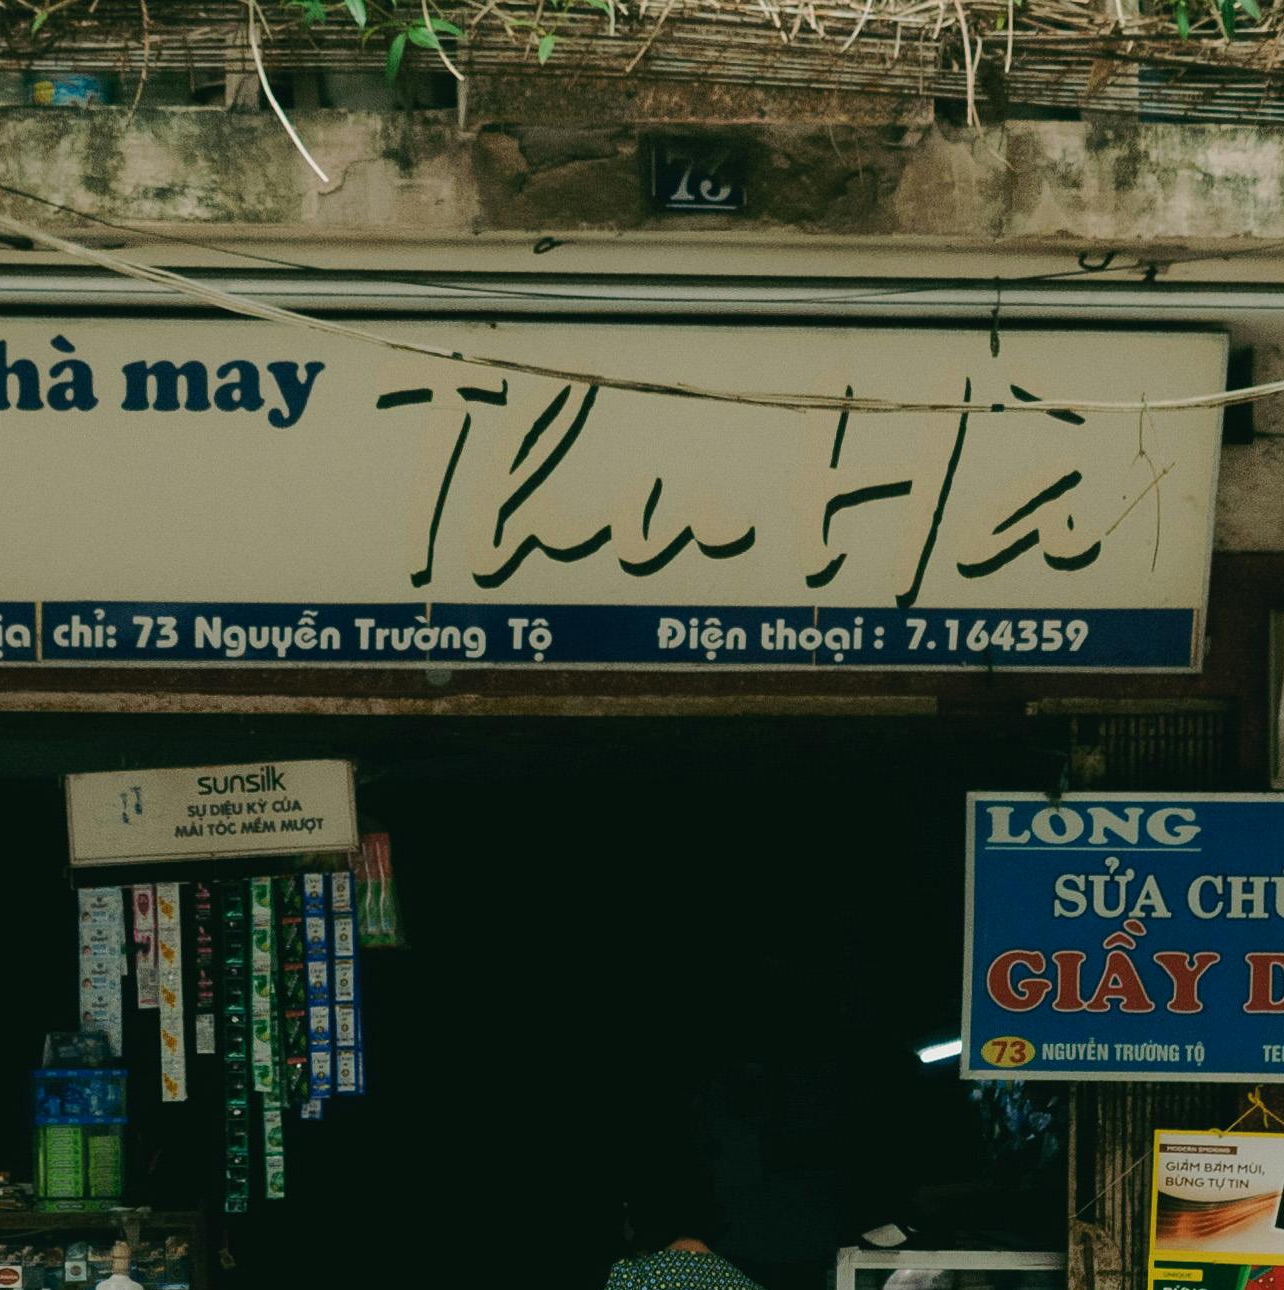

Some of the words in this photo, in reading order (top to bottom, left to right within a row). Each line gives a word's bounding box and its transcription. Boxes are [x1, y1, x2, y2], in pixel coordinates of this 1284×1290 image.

[121, 360, 325, 429] may
[132, 616, 178, 650] 73
[195, 611, 341, 660] Nguyễn
[508, 616, 553, 663] Tộ
[657, 618, 747, 661] Điện
[906, 620, 1089, 656] 7.164359
[197, 766, 286, 796] sunsilk
[986, 806, 1202, 846] LONG
[1053, 856, 1172, 919] SỬA
[986, 919, 1220, 1014] GIẦY
[991, 1040, 1029, 1064] 73
[1042, 1036, 1110, 1062] NGUYỄN
[1185, 1040, 1206, 1067] TỘ
[1228, 1178, 1250, 1189] TIN
